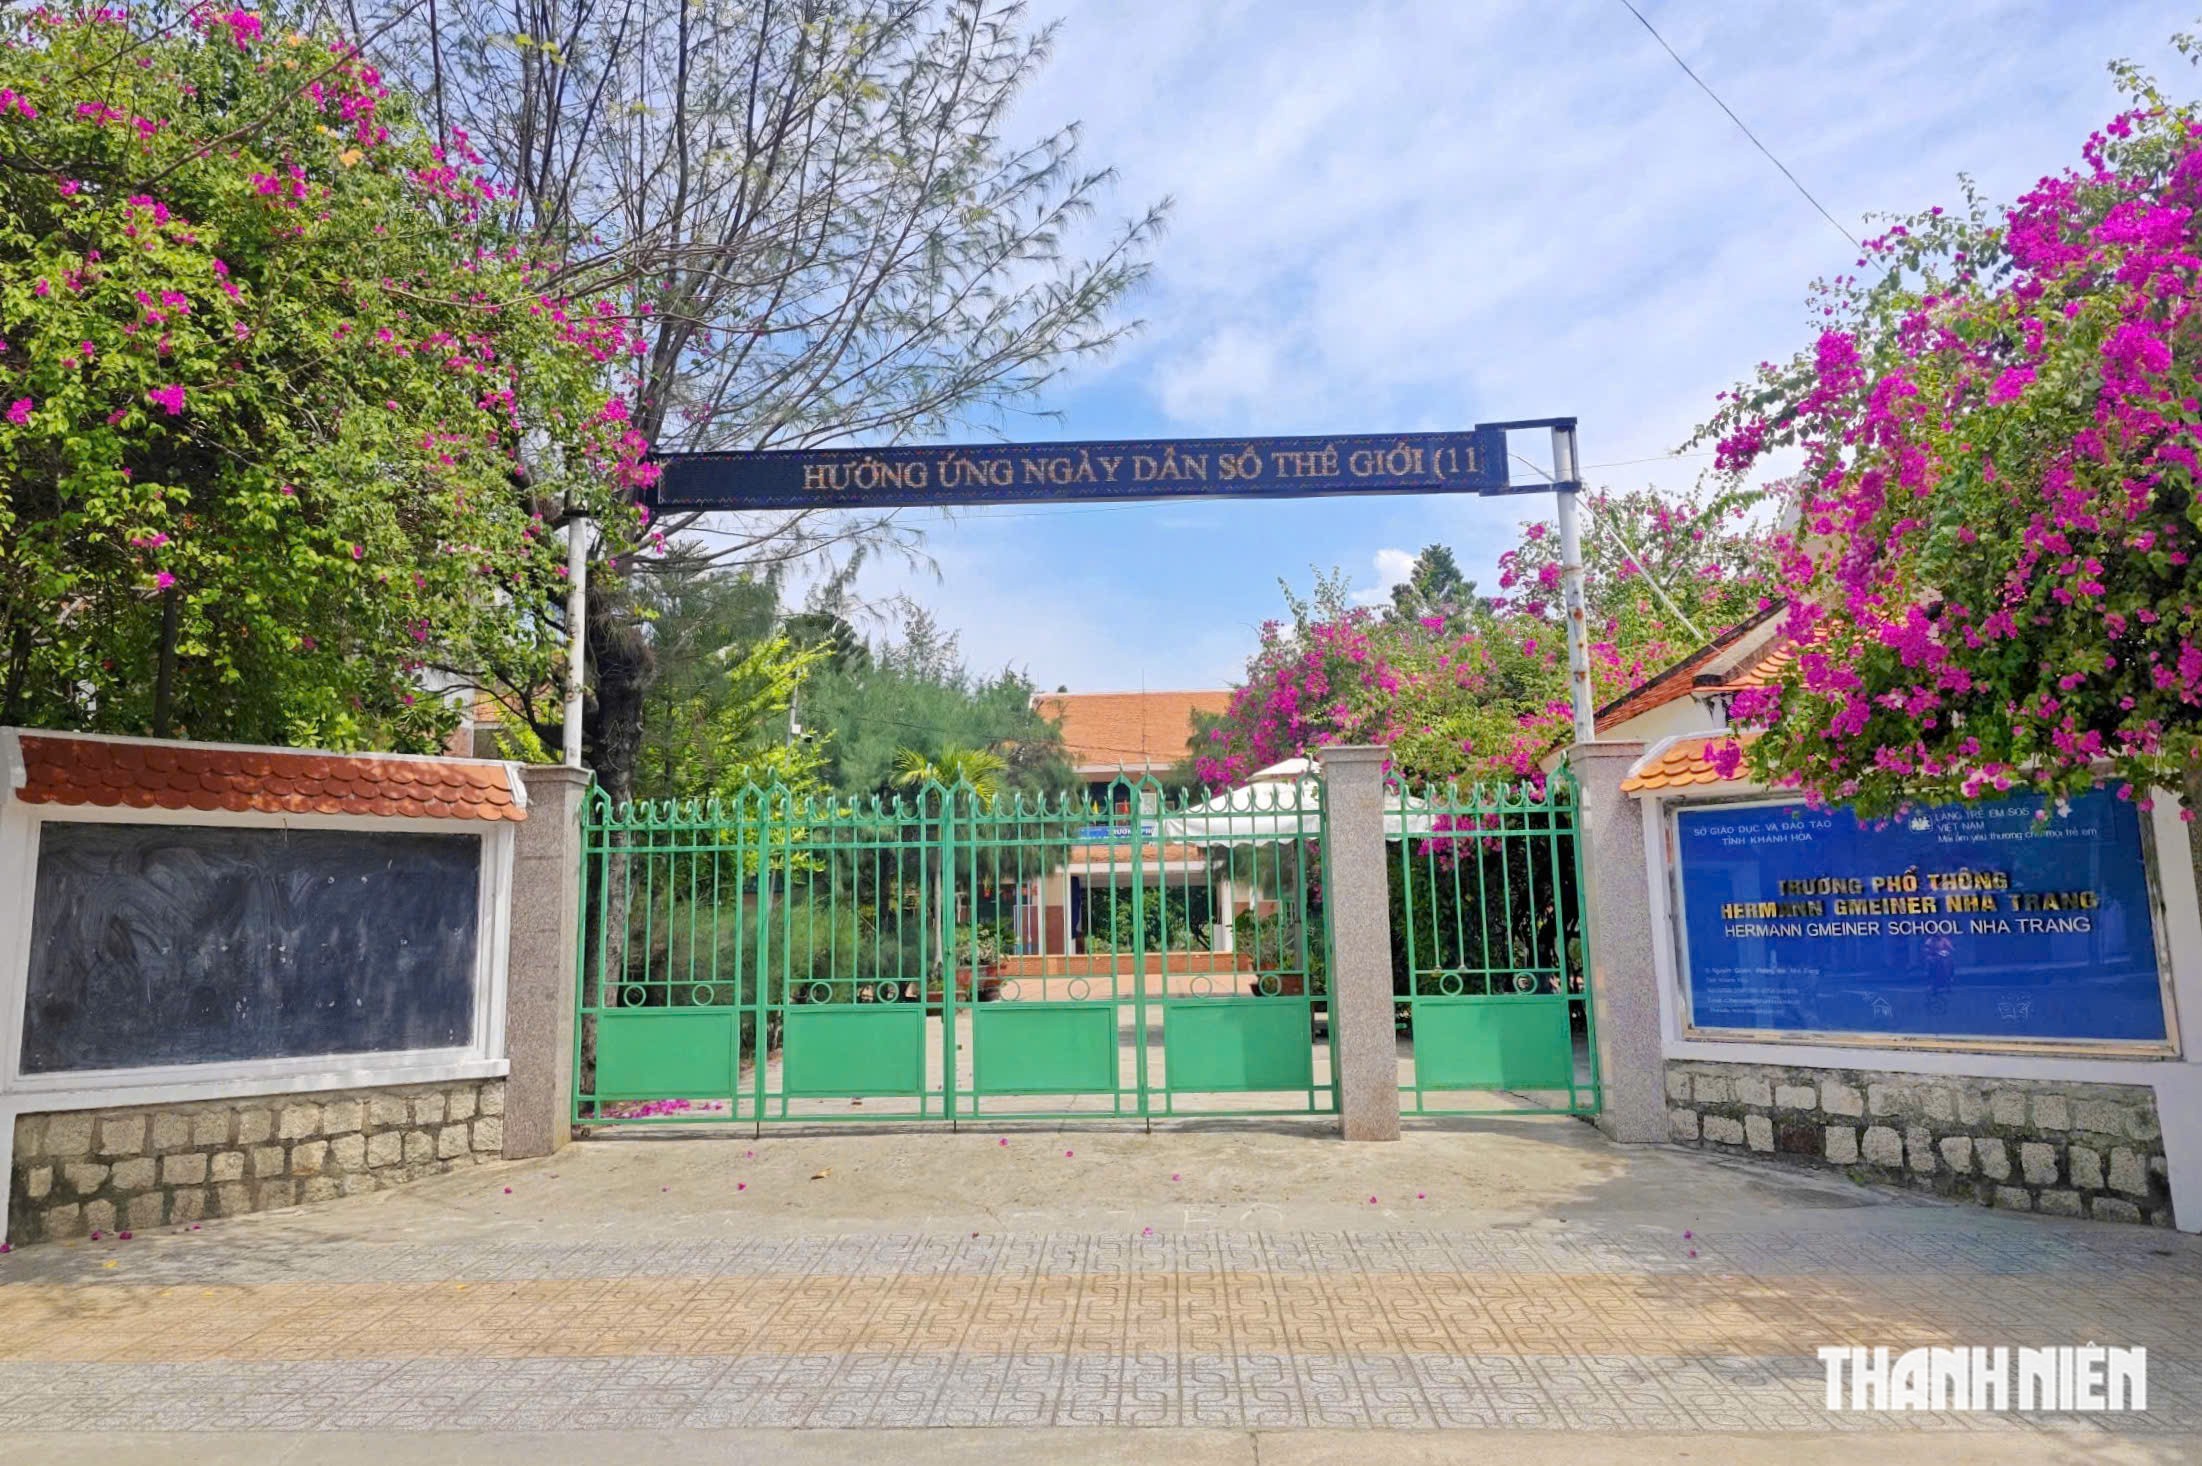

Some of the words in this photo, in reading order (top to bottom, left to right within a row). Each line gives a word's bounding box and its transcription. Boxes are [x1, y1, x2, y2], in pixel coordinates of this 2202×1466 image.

[937, 449, 1013, 486] ỨNG
[1021, 449, 1124, 485] NGÀY
[1349, 441, 1425, 477] GIỚI
[2008, 807, 2030, 817] SOS
[1710, 825, 1735, 836] GIÁO
[1738, 823, 1760, 835] DỤC
[1962, 821, 1985, 831] NAM
[1872, 865, 1917, 894] PHỔ
[1927, 867, 2008, 891] THÔNG
[1721, 900, 1823, 919] HERMANN
[1834, 896, 1937, 916] GMEINER
[1946, 894, 1997, 913] NHA
[2008, 890, 2098, 912] TRANG
[1725, 922, 1801, 937] HERMANN
[1807, 921, 1880, 936] GMEINER
[1887, 919, 1963, 935] SCHOOL
[1970, 918, 2011, 934] NHA
[2015, 916, 2091, 933] TRANG
